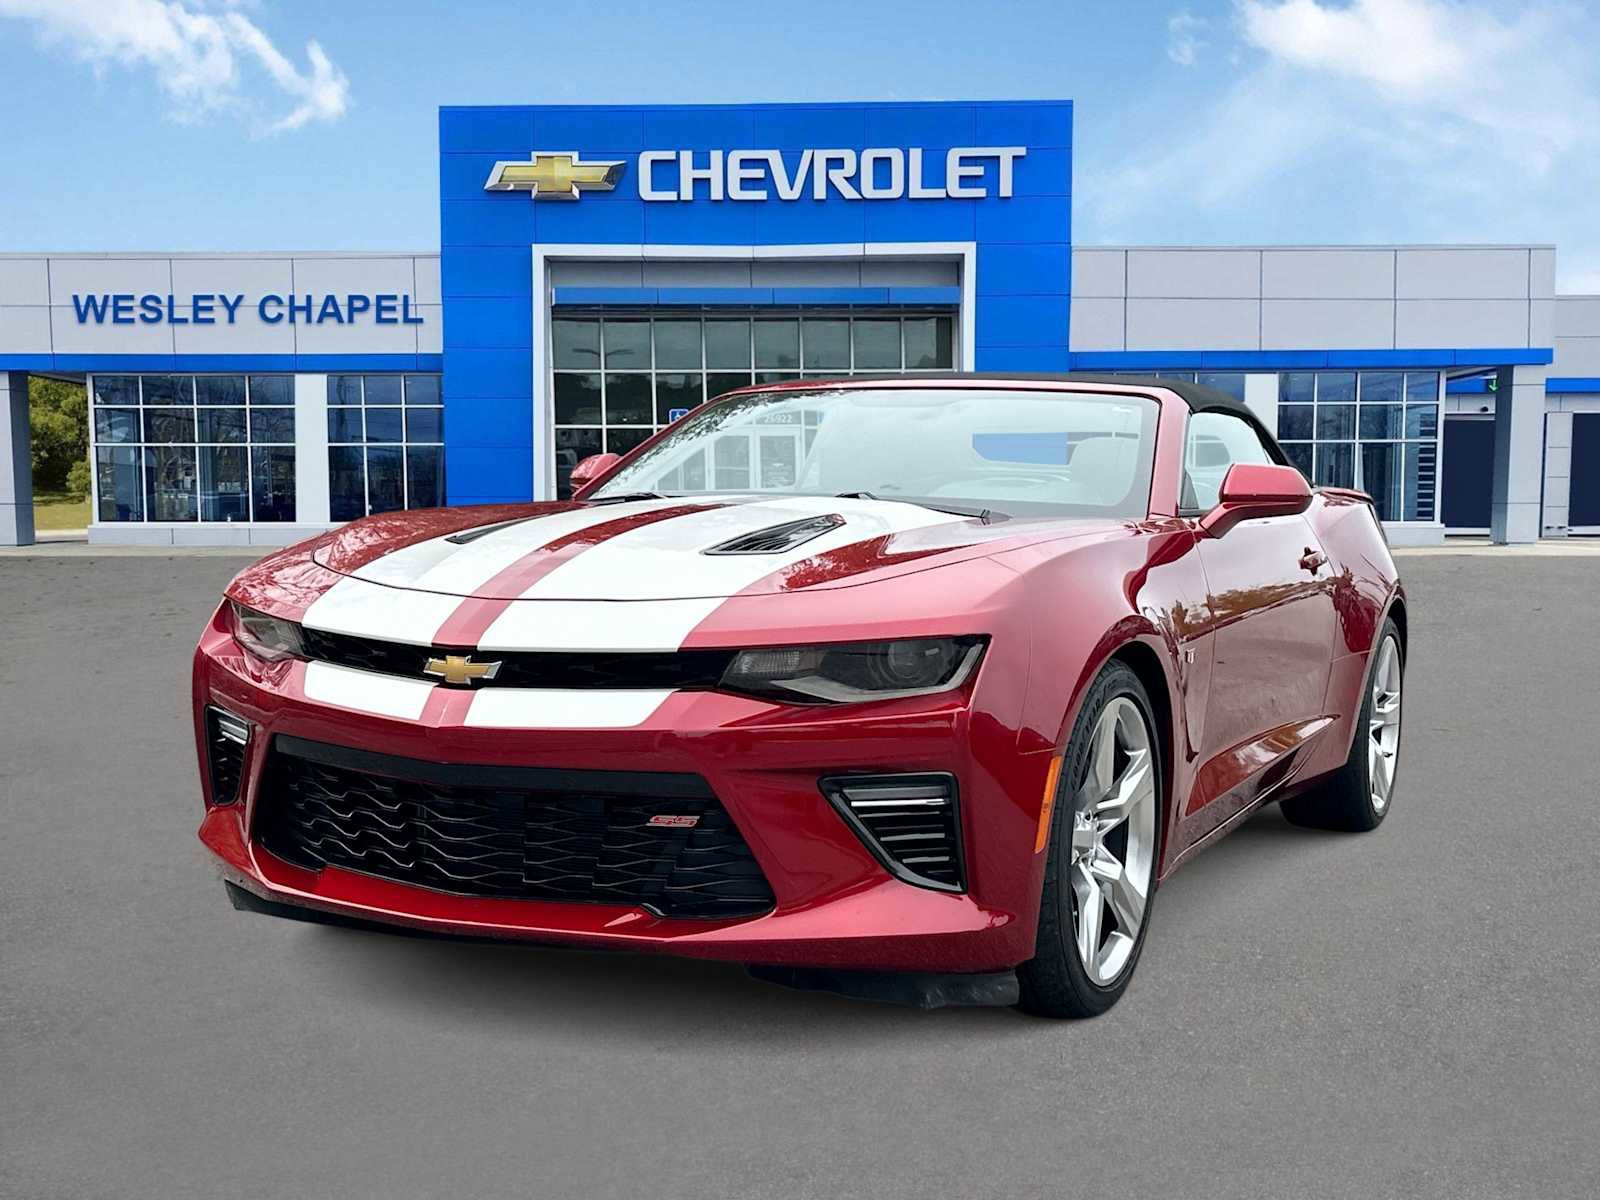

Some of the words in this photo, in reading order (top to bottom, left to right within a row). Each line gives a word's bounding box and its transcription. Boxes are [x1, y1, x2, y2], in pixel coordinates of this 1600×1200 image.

[638, 146, 1027, 201] CHEVROLET
[72, 294, 245, 324] WESLEY
[258, 293, 424, 324] CHAPEL
[645, 815, 700, 828] SS
